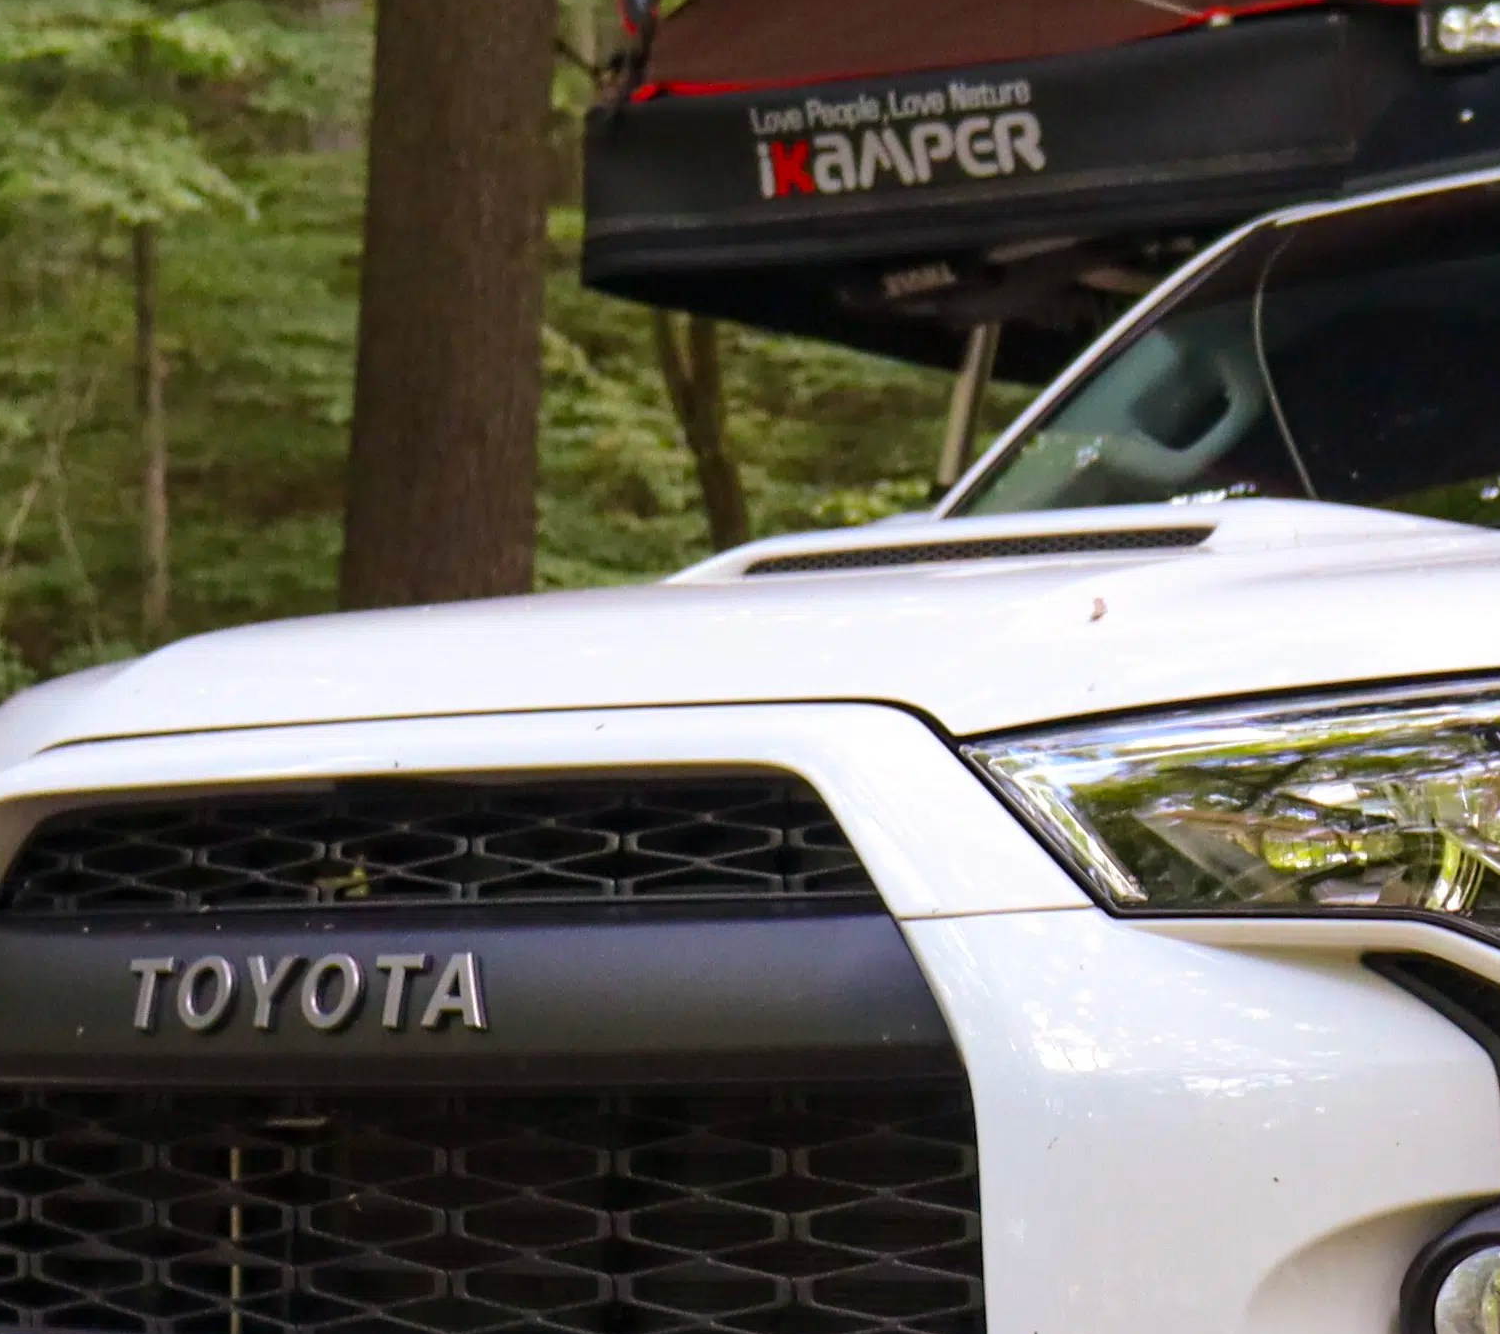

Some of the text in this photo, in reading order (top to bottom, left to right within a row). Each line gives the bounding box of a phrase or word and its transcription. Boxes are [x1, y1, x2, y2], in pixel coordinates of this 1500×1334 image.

[749, 106, 802, 136] Love
[887, 88, 946, 117] Love
[947, 78, 1033, 113] Nature
[129, 951, 488, 1031] TOYOTA
